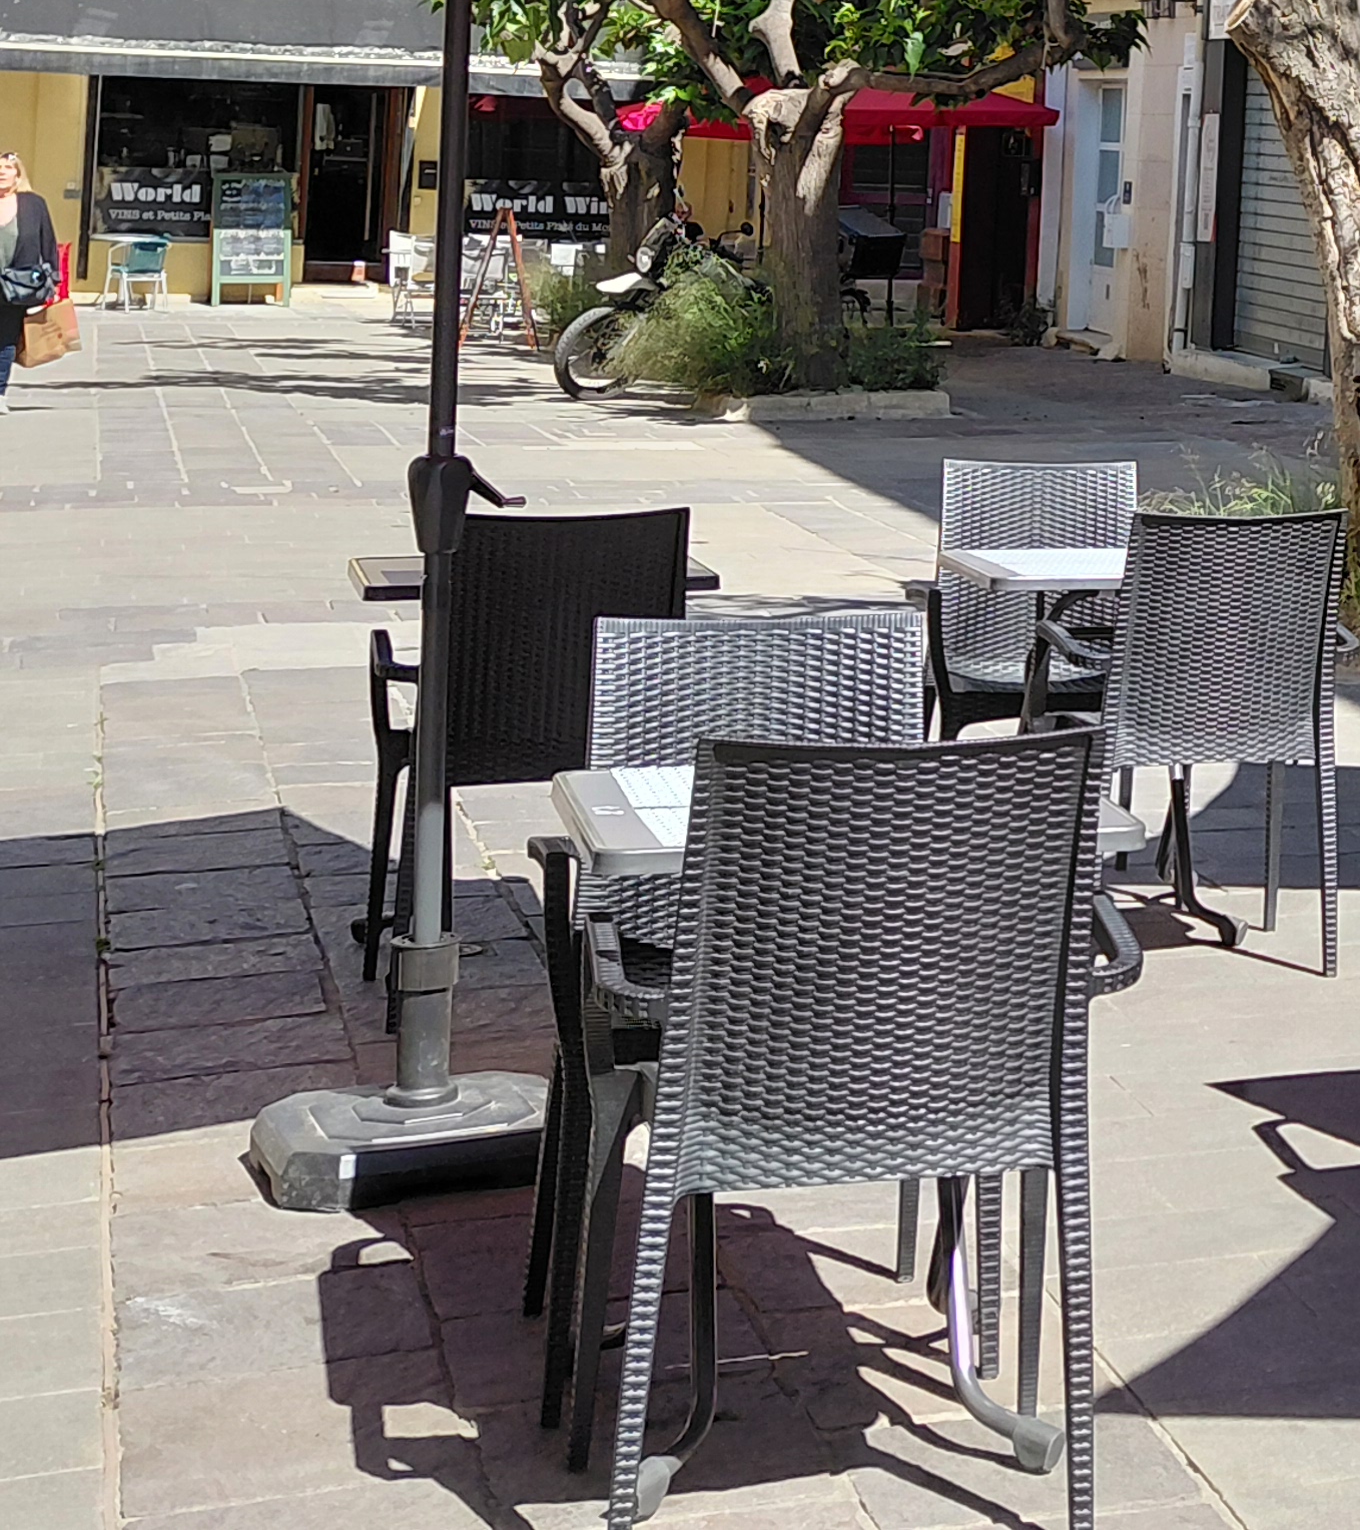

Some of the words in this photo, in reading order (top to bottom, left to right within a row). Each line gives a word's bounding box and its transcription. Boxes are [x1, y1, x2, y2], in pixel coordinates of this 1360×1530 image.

[110, 182, 201, 204] World
[470, 193, 554, 214] World
[108, 209, 140, 220] VINS
